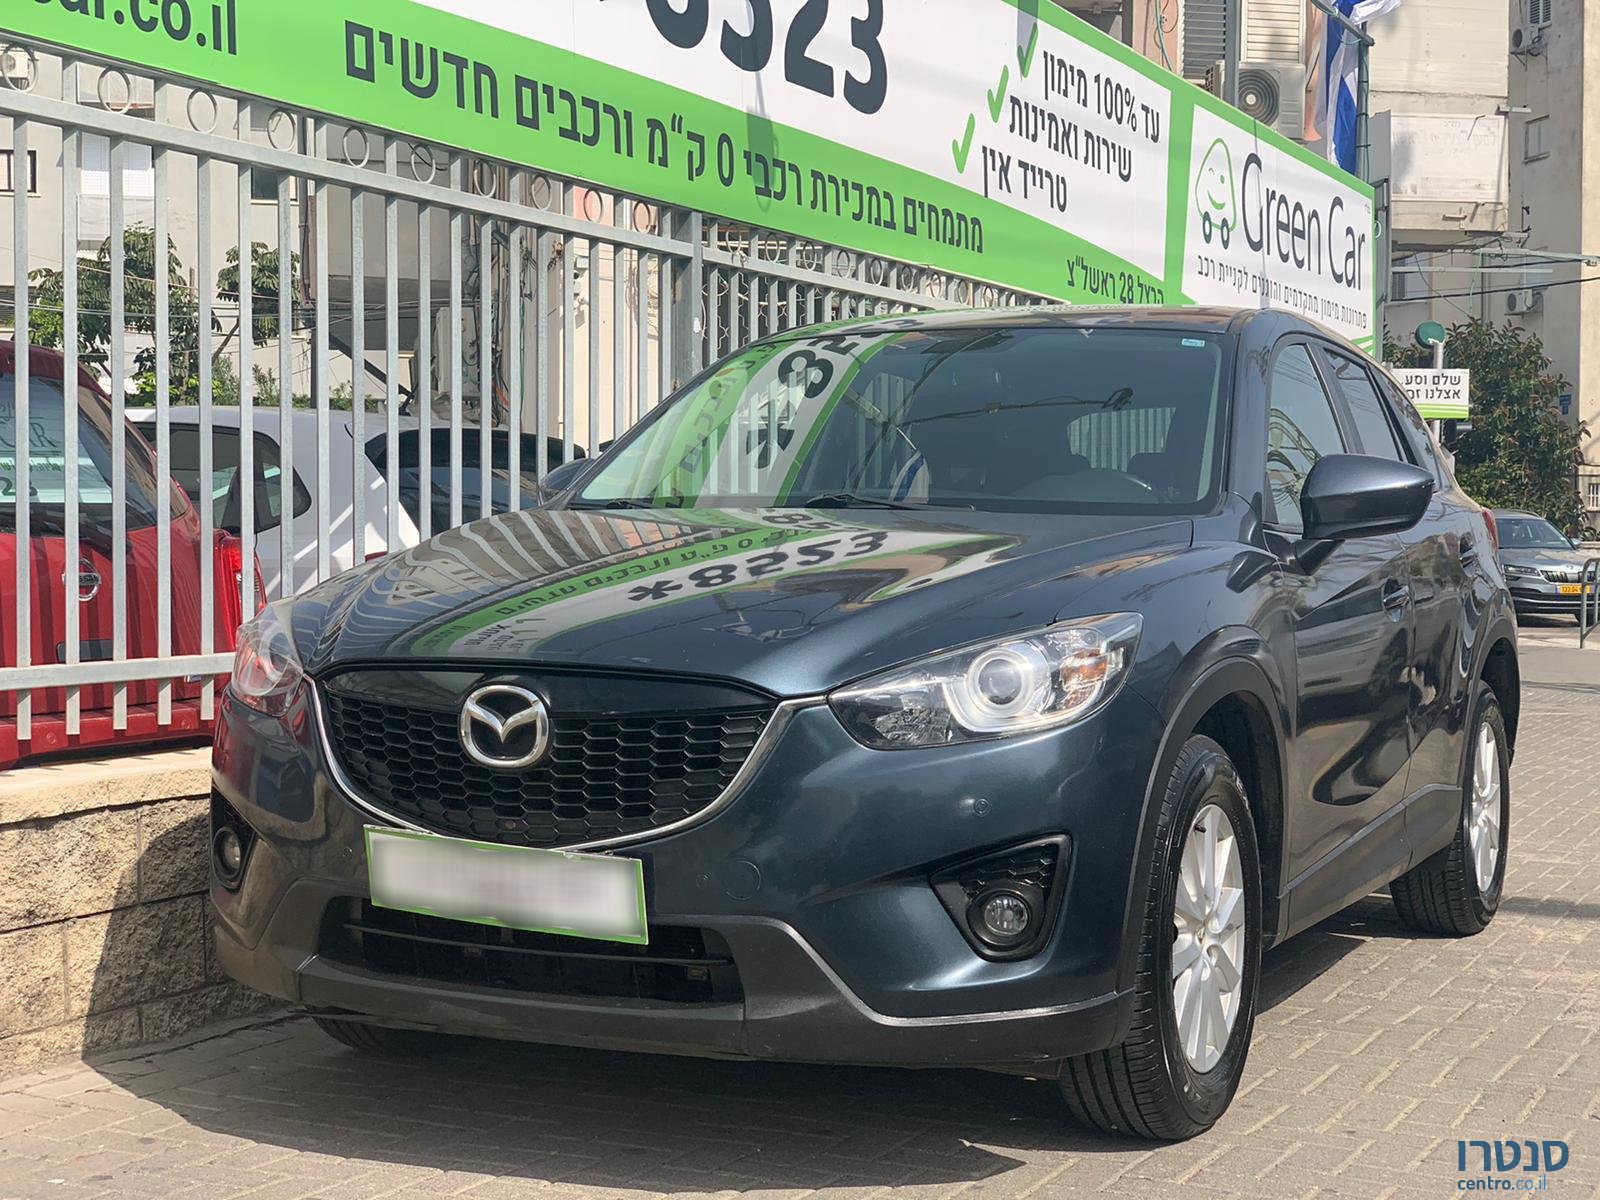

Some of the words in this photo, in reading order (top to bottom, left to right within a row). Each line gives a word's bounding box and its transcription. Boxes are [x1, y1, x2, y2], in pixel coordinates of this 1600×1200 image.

[344, 19, 500, 119] חדשים
[1043, 50, 1088, 108] מימון
[514, 74, 634, 158] ורכבים
[1009, 95, 1079, 160] ואמינות
[1094, 73, 1137, 132] 100%
[1141, 103, 1160, 143] עד
[717, 133, 735, 187] 0
[743, 149, 803, 206] רכבי
[982, 145, 1012, 198] אין
[1084, 129, 1132, 182] שירות
[810, 169, 897, 231] במכירת
[1018, 159, 1068, 213] טרייד
[904, 196, 984, 254] מתמחים
[1241, 152, 1322, 275] Green
[1328, 195, 1366, 291] Car
[1119, 271, 1134, 304] 28
[1197, 254, 1216, 280] רכב
[1218, 264, 1249, 294] לקניית
[1284, 285, 1319, 316] מתקדמים
[1320, 297, 1340, 321] מימון
[1425, 387, 1461, 400] אצלנו
[1432, 373, 1461, 386] שלם
